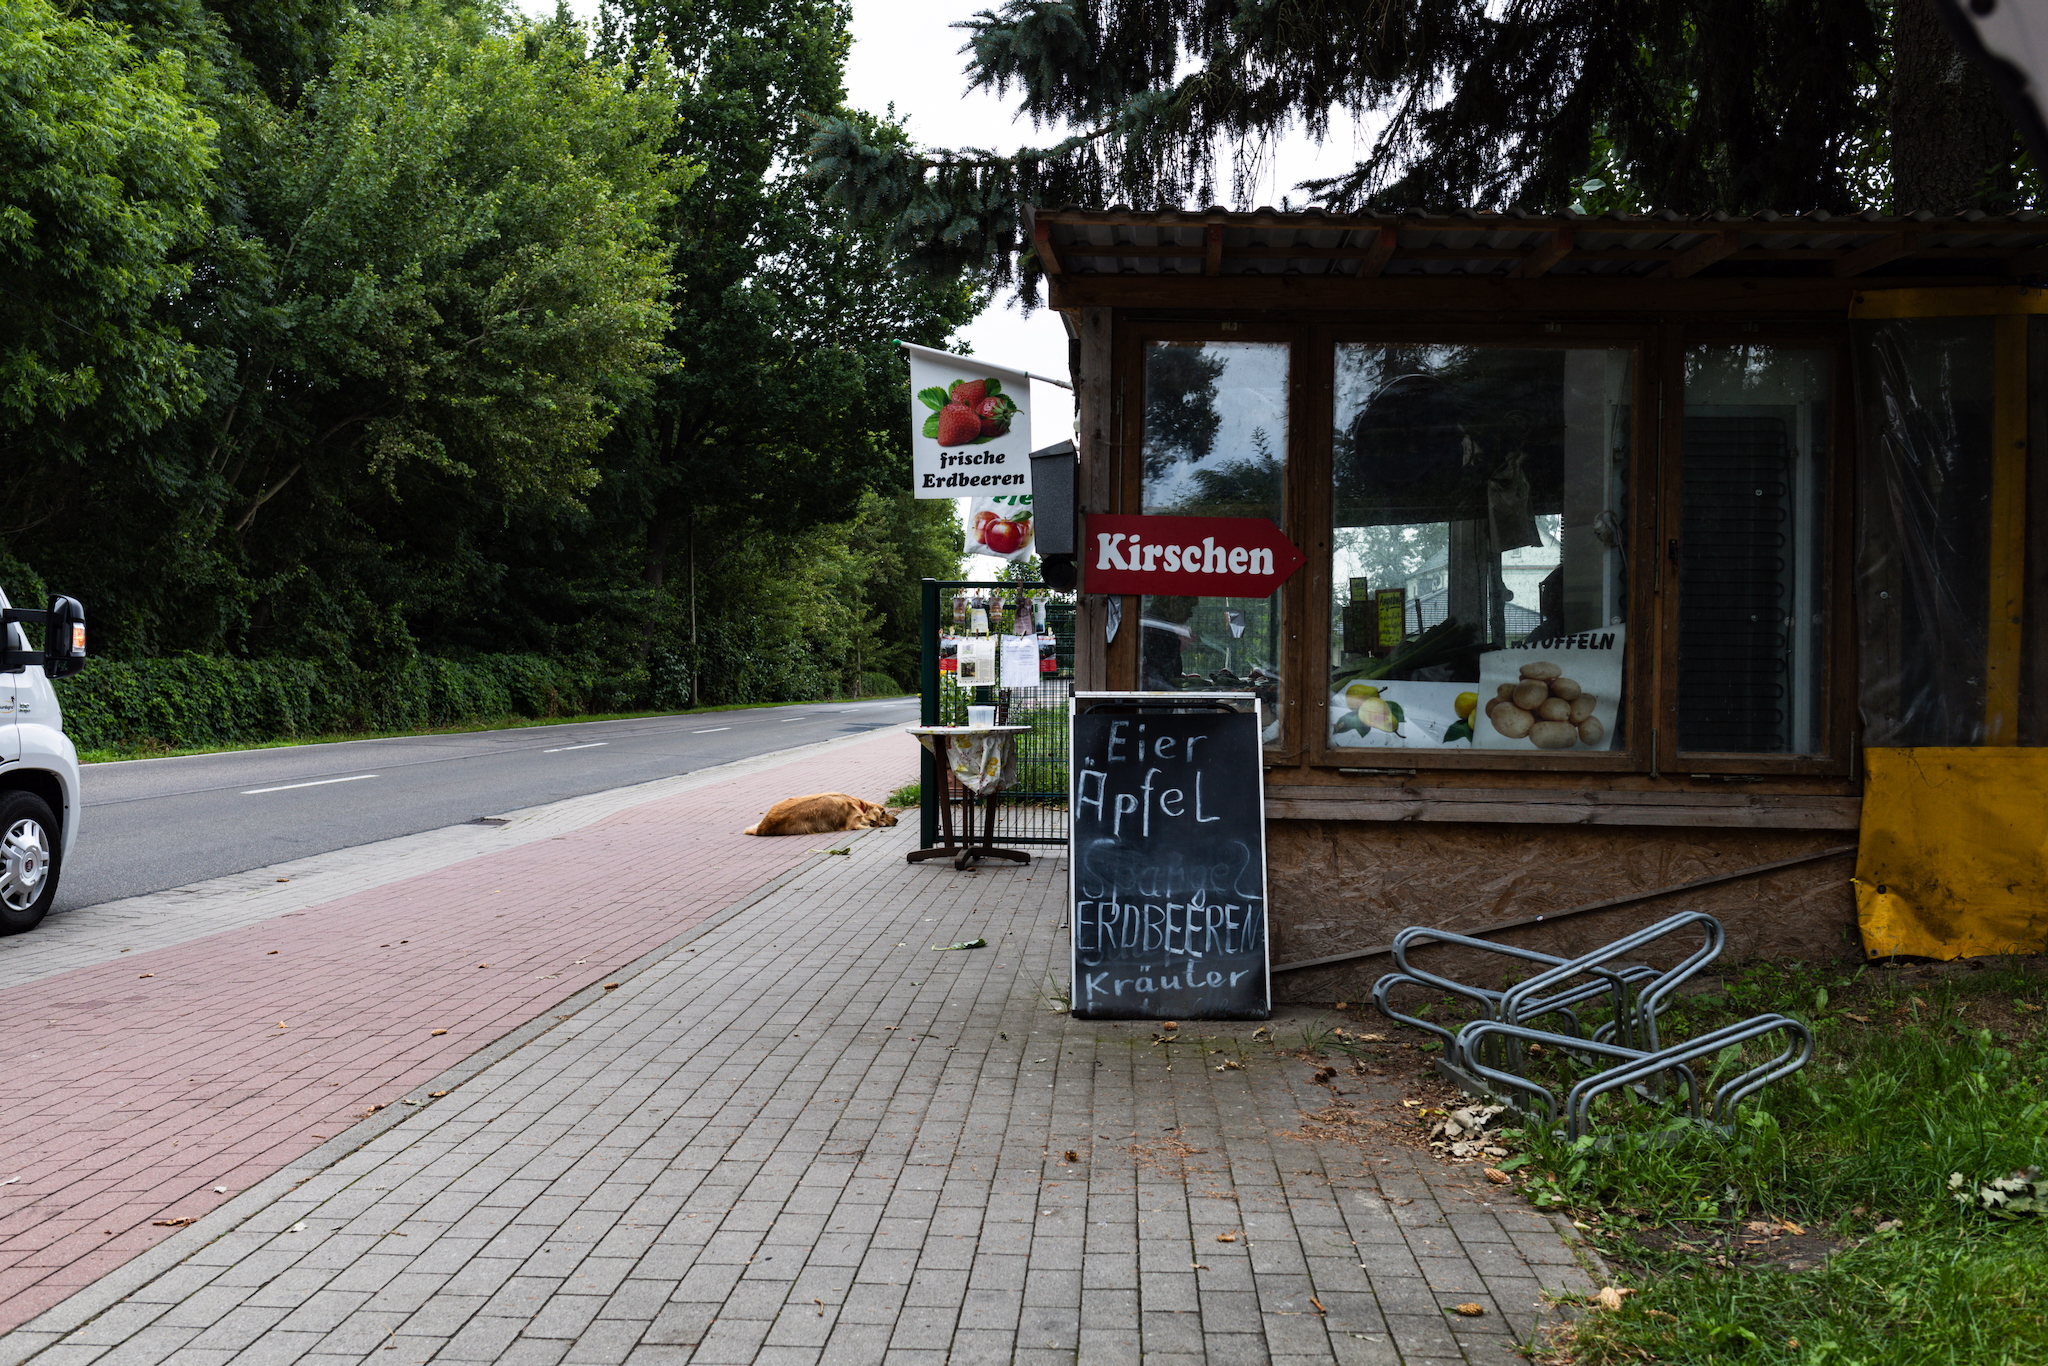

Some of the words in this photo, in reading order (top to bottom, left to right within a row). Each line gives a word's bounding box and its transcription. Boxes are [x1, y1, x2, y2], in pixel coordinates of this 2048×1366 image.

[922, 472, 1025, 488] Erdbeeren
[940, 450, 1005, 469] frische
[1096, 533, 1275, 575] Kirschen
[1107, 720, 1208, 763] Eier
[1076, 900, 1262, 957] ERDBEEREN
[1085, 958, 1249, 1001] Kräuter
